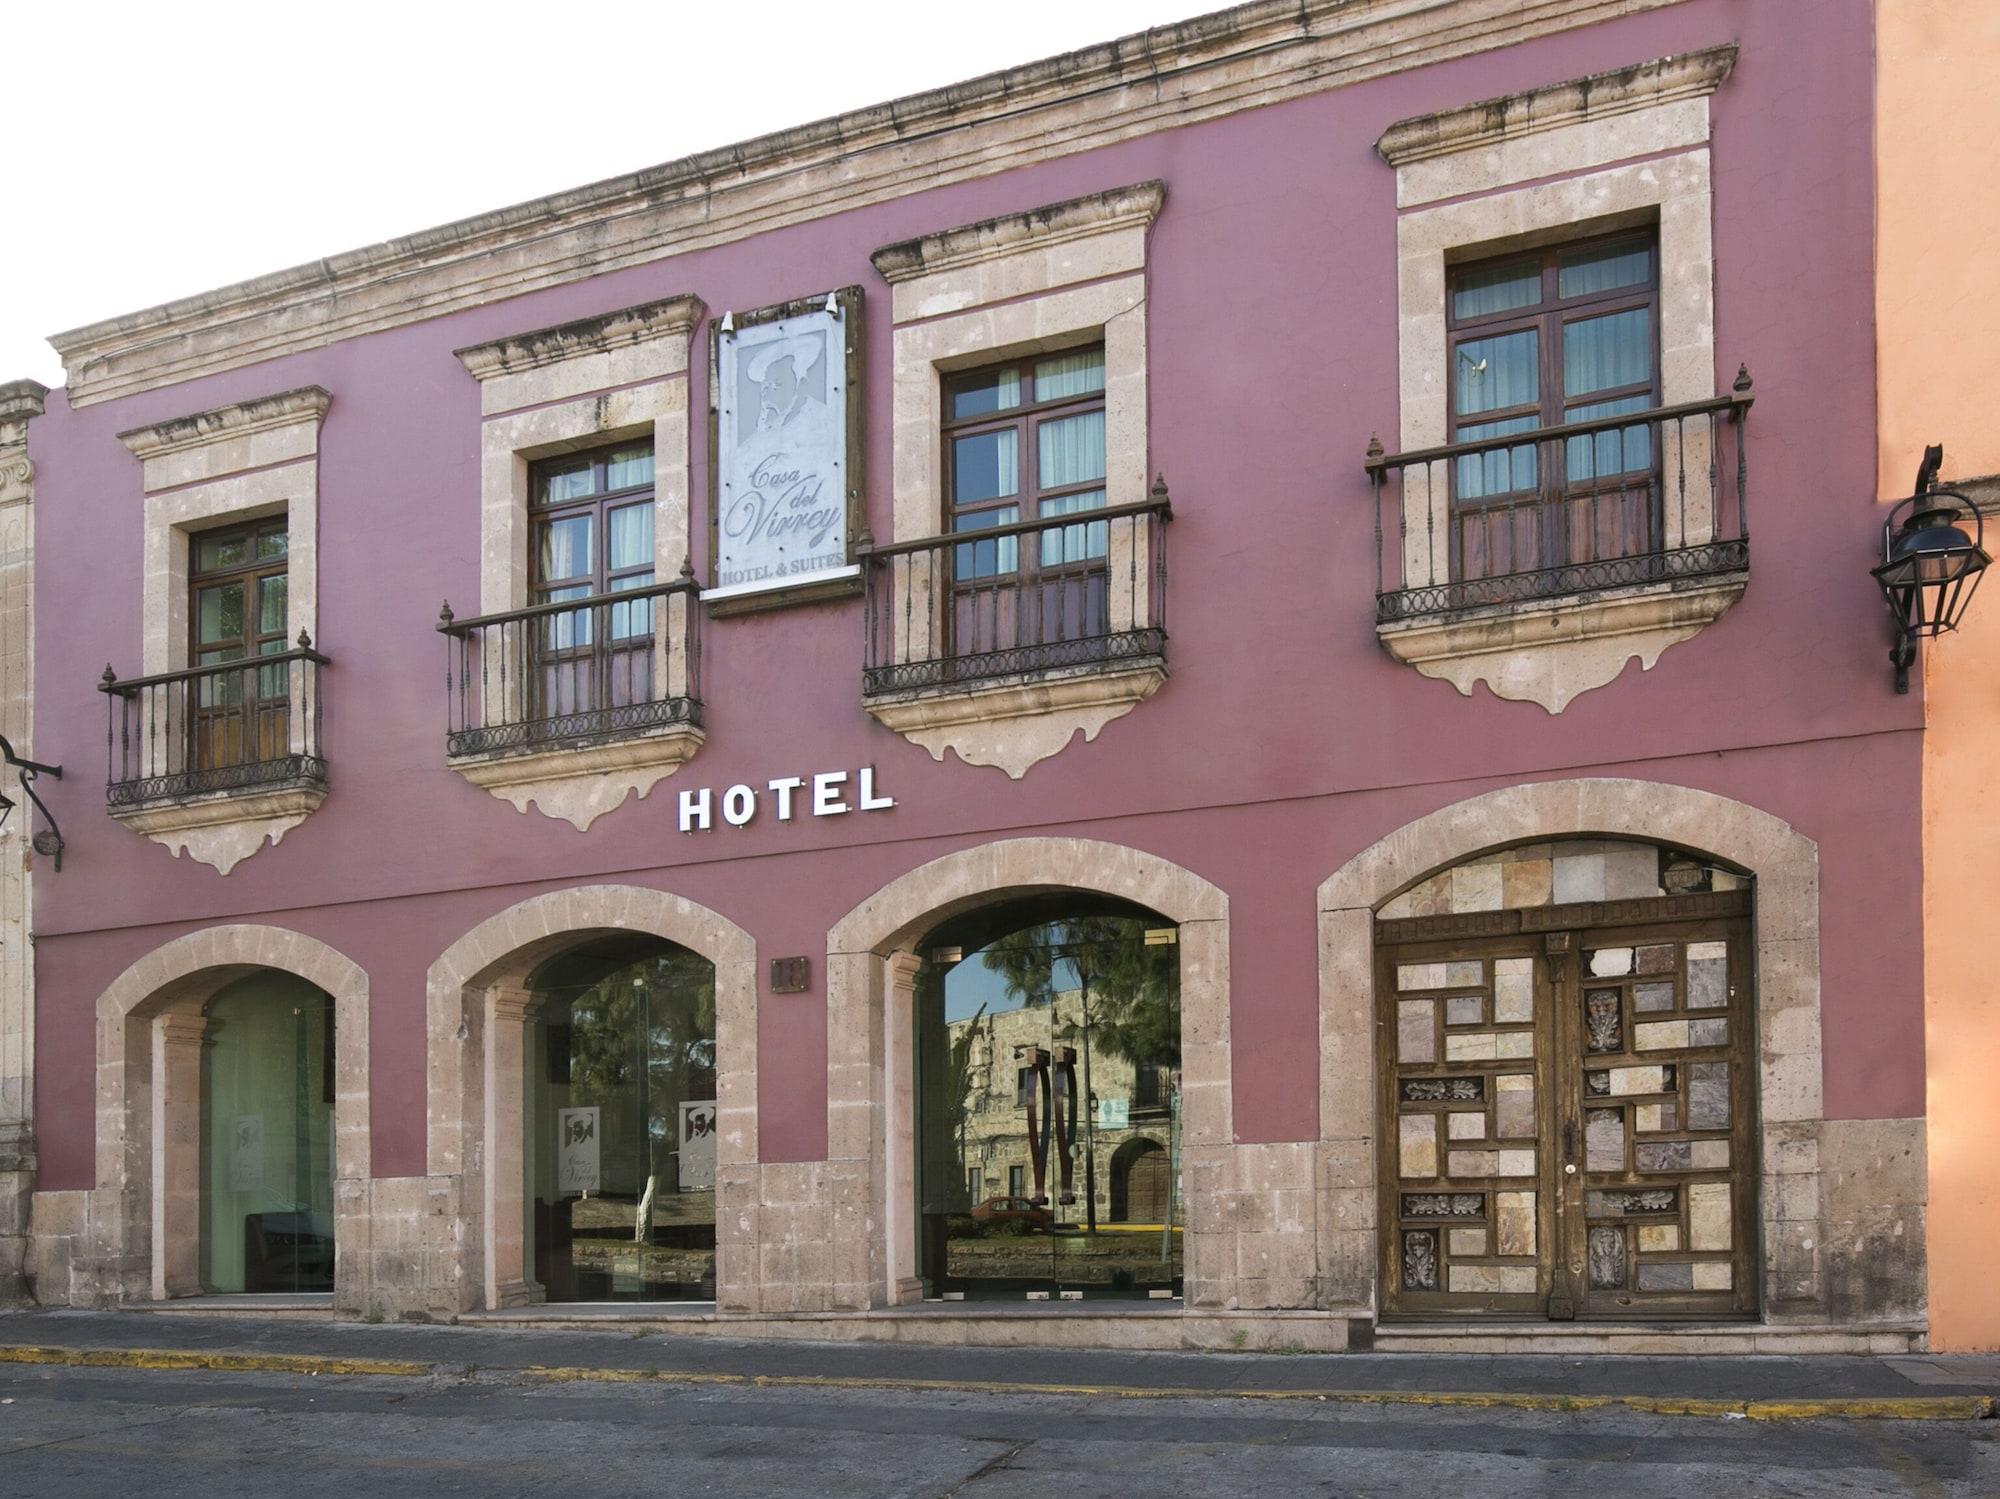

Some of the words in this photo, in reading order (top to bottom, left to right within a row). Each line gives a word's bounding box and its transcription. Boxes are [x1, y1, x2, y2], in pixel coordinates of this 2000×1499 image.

[748, 453, 800, 488] Casa
[789, 479, 825, 509] del
[724, 475, 841, 549] Virrey
[723, 565, 773, 585] HOTEL
[775, 563, 787, 578] &
[791, 552, 844, 574] SUITES
[678, 767, 894, 832] HOTEL
